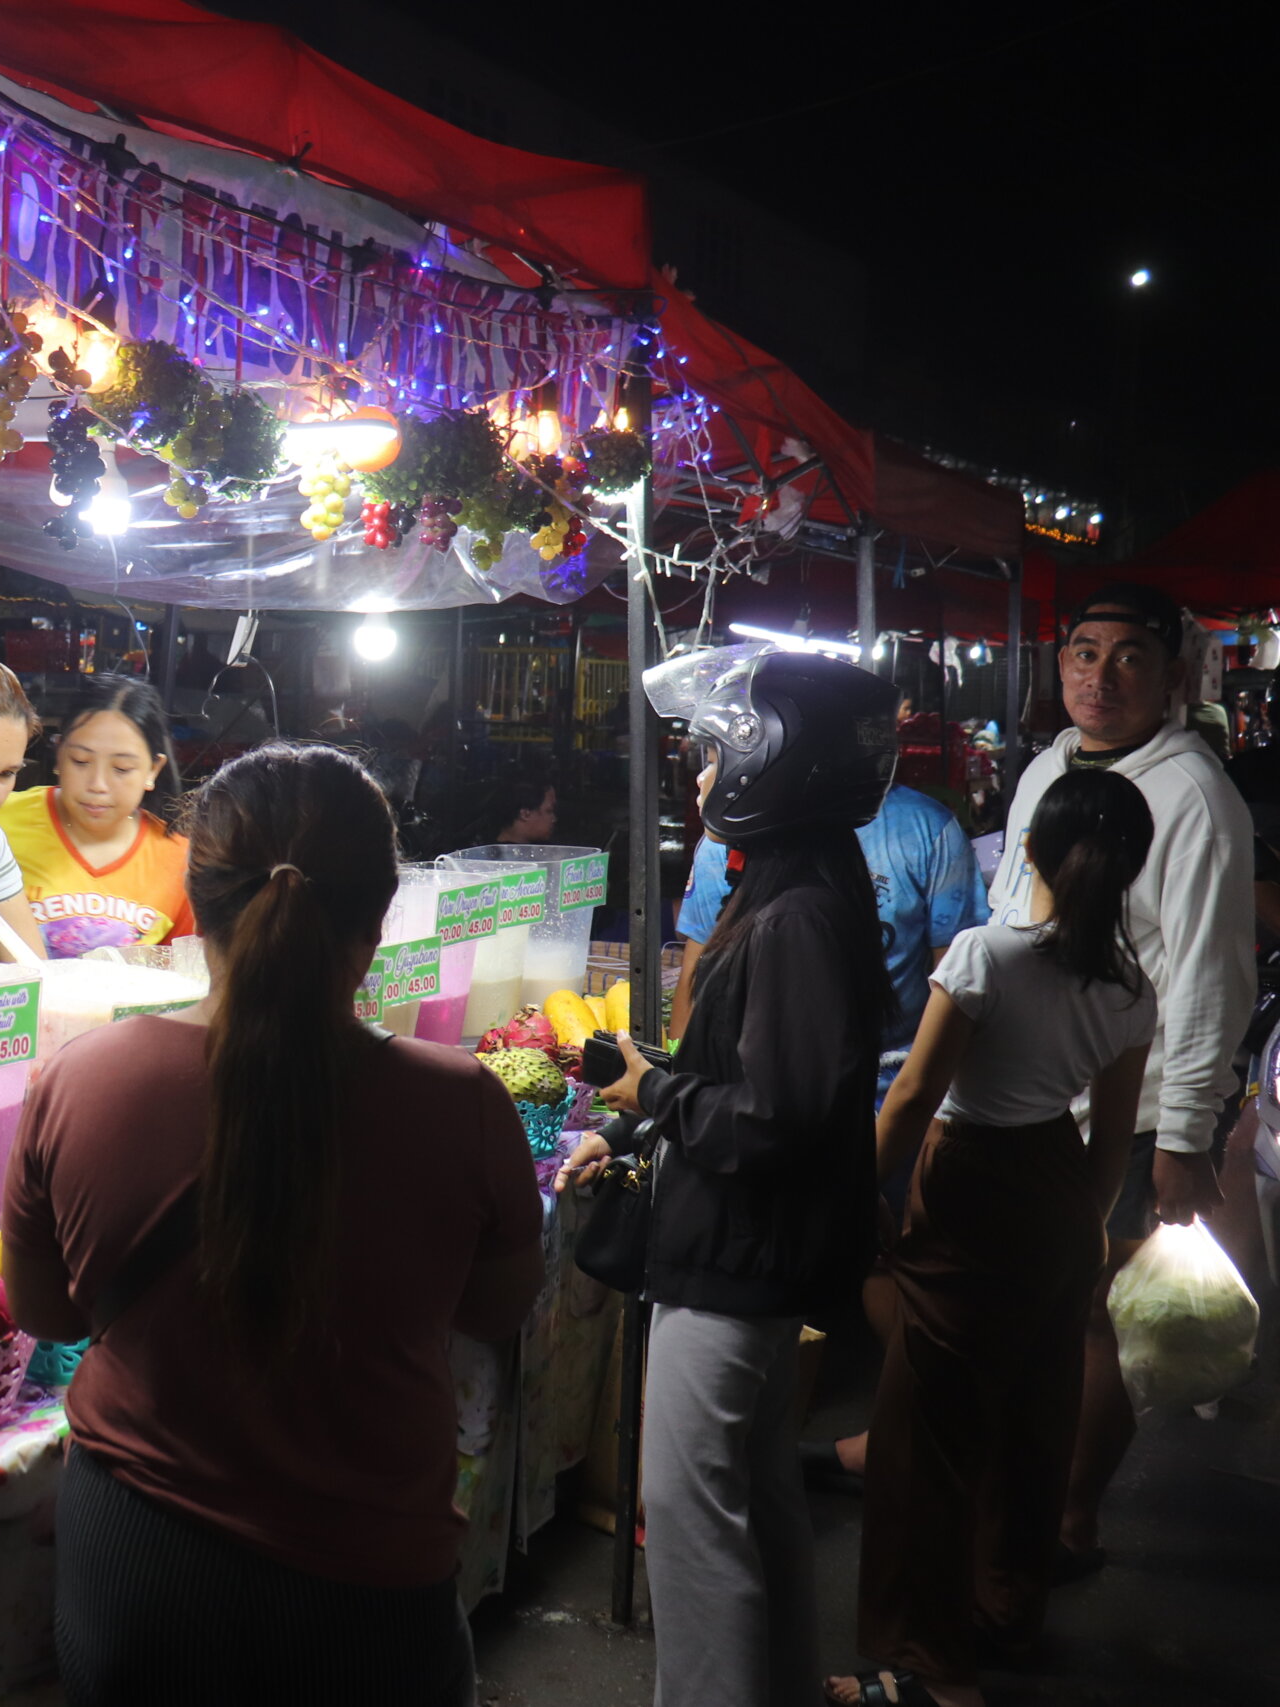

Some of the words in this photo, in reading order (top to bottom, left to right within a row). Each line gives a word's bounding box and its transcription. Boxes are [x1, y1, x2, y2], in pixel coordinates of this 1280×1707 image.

[29, 892, 156, 931] RENDING
[519, 904, 540, 918] 45.00
[469, 918, 493, 934] 45.00
[384, 983, 399, 1000] .00
[408, 975, 435, 993] 45.00
[11, 991, 28, 1006] with
[353, 1001, 378, 1017] 5.00
